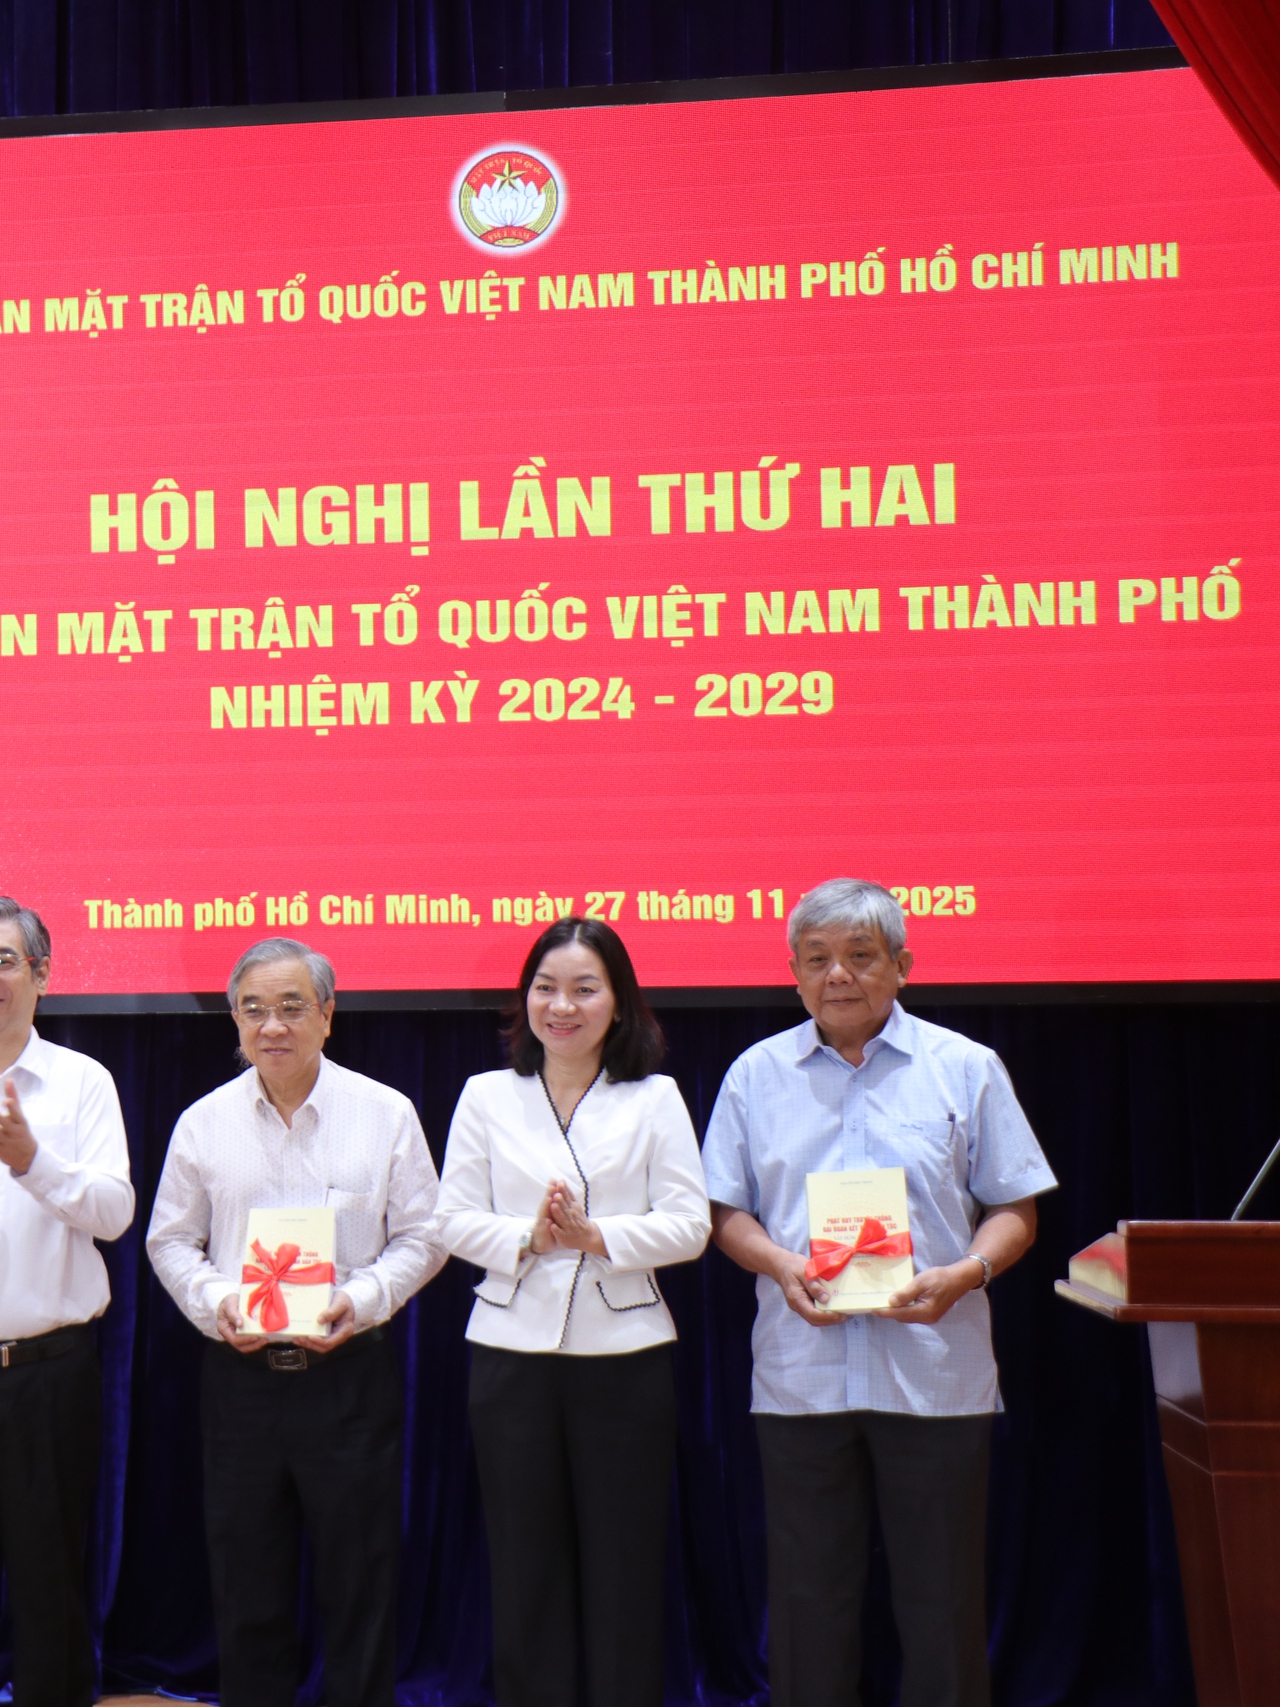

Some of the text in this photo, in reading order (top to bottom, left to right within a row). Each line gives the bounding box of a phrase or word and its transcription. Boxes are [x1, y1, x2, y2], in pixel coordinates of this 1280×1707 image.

[44, 288, 128, 338] MẶT
[140, 284, 244, 333] TRẬN
[257, 273, 306, 323] TỔ
[319, 270, 426, 324] QUỐC
[440, 270, 525, 320] VIỆT
[539, 272, 634, 310] NAM
[647, 260, 786, 305] THÀNH
[801, 247, 885, 298] PHỐ
[900, 244, 957, 293] HỒ
[972, 243, 1044, 289] CHÍ
[1059, 242, 1178, 284] MINH
[90, 456, 956, 565] HỘI NGHỊ LẦN THỨ HAI
[57, 601, 173, 663] MẶT
[189, 597, 333, 658] TRẬN
[351, 585, 420, 646] TỔ
[438, 582, 587, 649] QUỐC
[606, 585, 726, 647] VIỆT
[745, 588, 880, 635] NAM
[899, 575, 1096, 630] THÀNH
[1119, 558, 1241, 623] PHỐ
[210, 670, 834, 736] NHIỆM KỲ 2024 - 2029
[83, 898, 183, 929] Thành
[194, 892, 258, 931] phố
[266, 891, 308, 926] Hồ
[320, 894, 374, 925] Chí
[386, 894, 480, 926] Minh,
[492, 891, 574, 926] ngày
[584, 891, 626, 921] 27
[637, 888, 734, 923] tháng
[747, 888, 784, 918] 11
